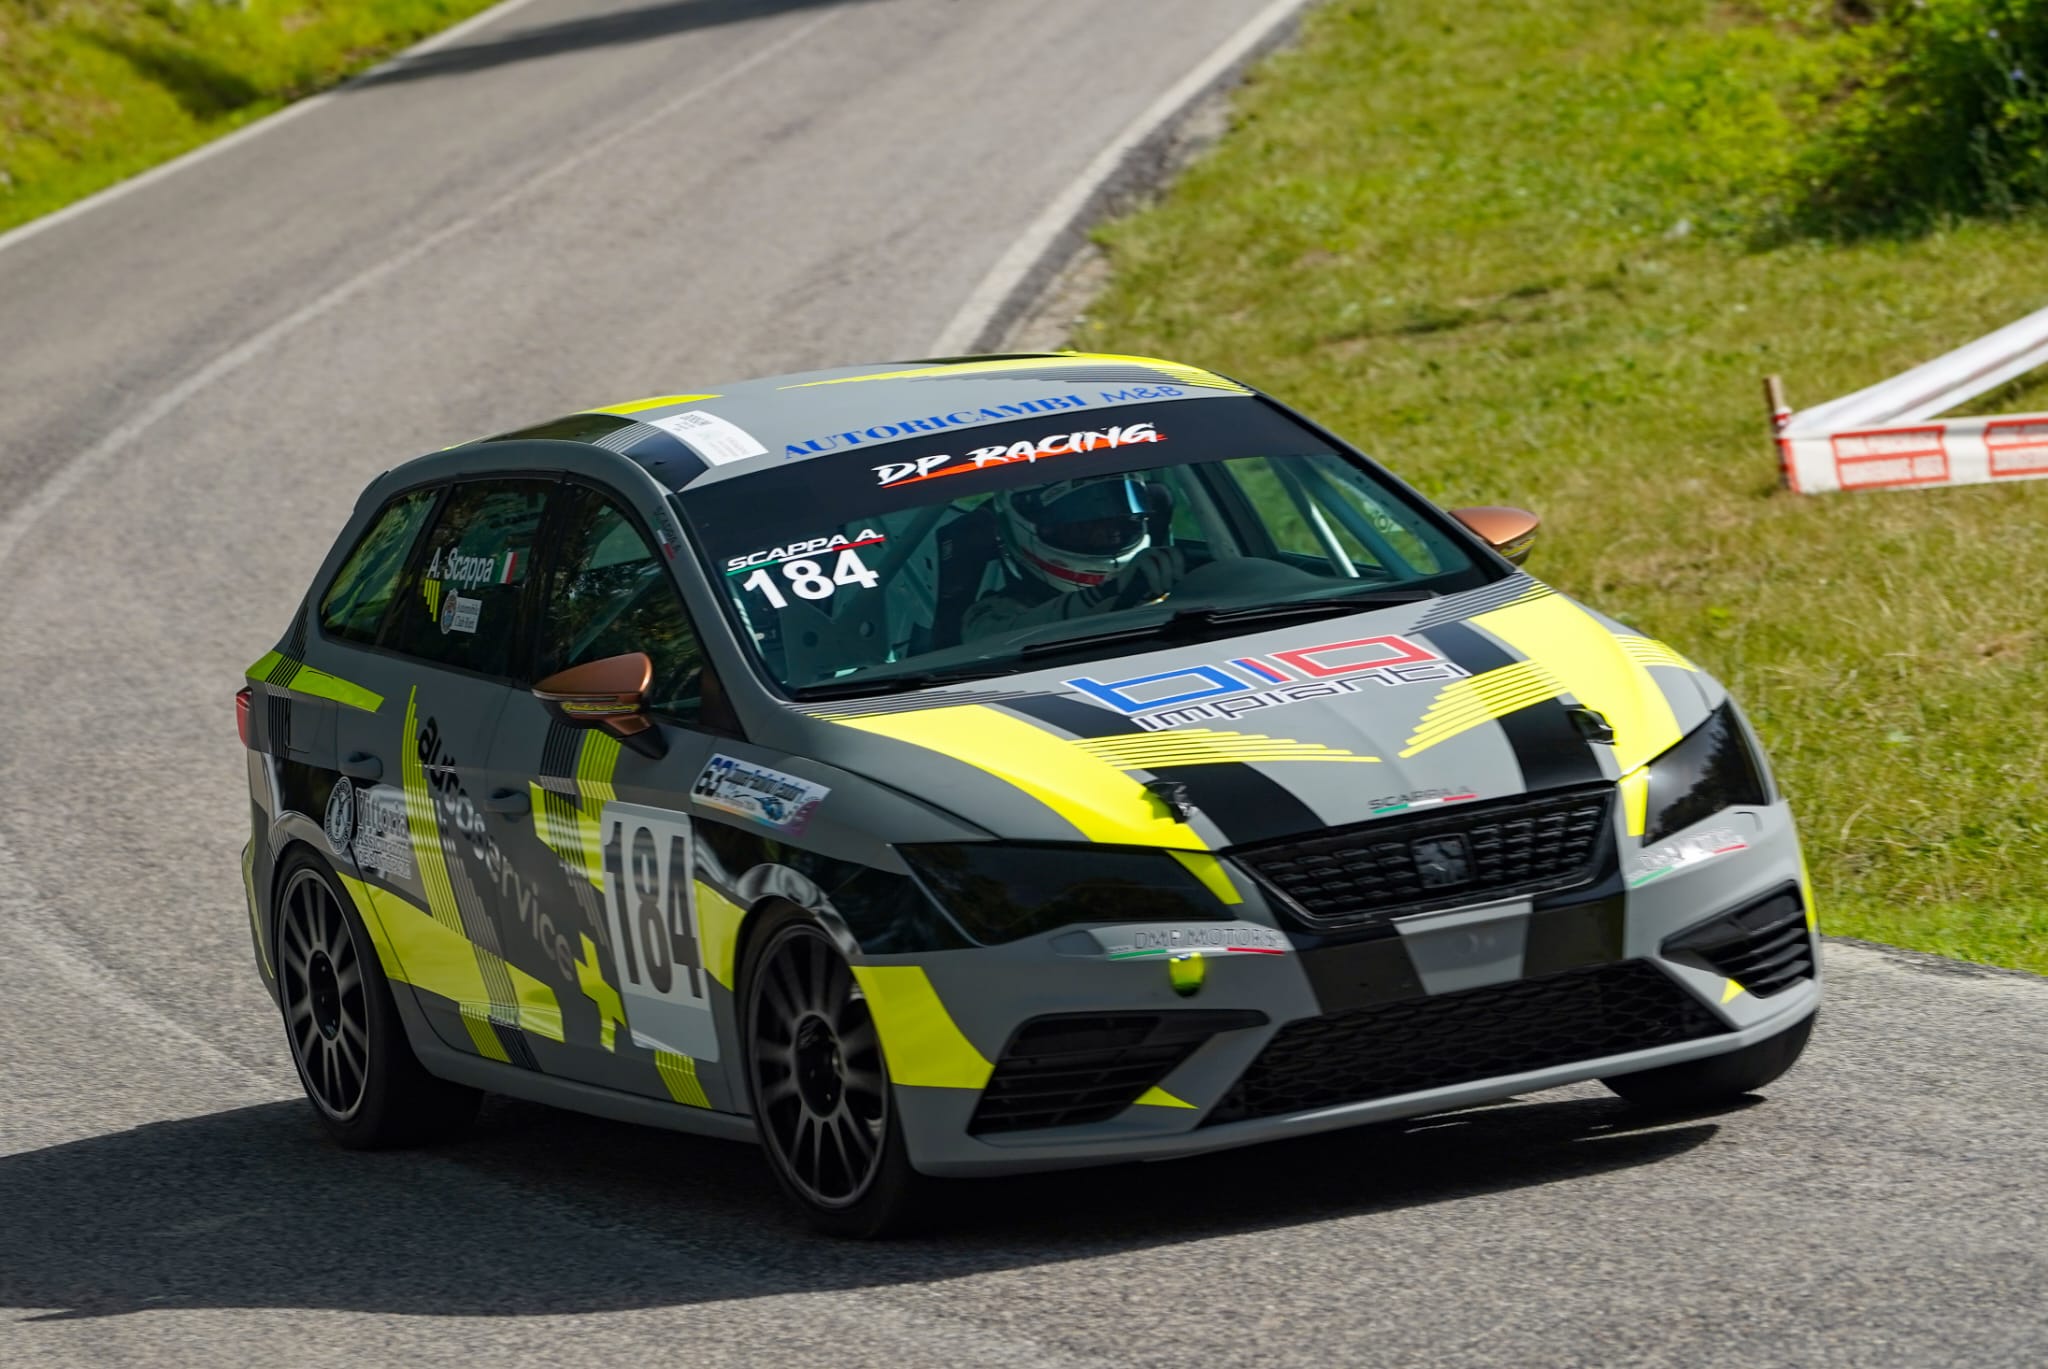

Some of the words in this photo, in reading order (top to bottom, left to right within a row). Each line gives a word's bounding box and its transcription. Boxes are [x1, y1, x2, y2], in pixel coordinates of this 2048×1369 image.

[785, 394, 1087, 459] AUTORICAMBI
[1100, 386, 1182, 403] M&B
[871, 453, 951, 486] DP
[966, 422, 1158, 468] RACING
[426, 546, 441, 579] A.
[443, 547, 495, 590] Scappa
[727, 534, 850, 572] SCAPPA
[854, 528, 884, 543] A
[742, 549, 880, 609] 184
[604, 821, 703, 999] 184
[1187, 928, 1278, 948] MOTORS
